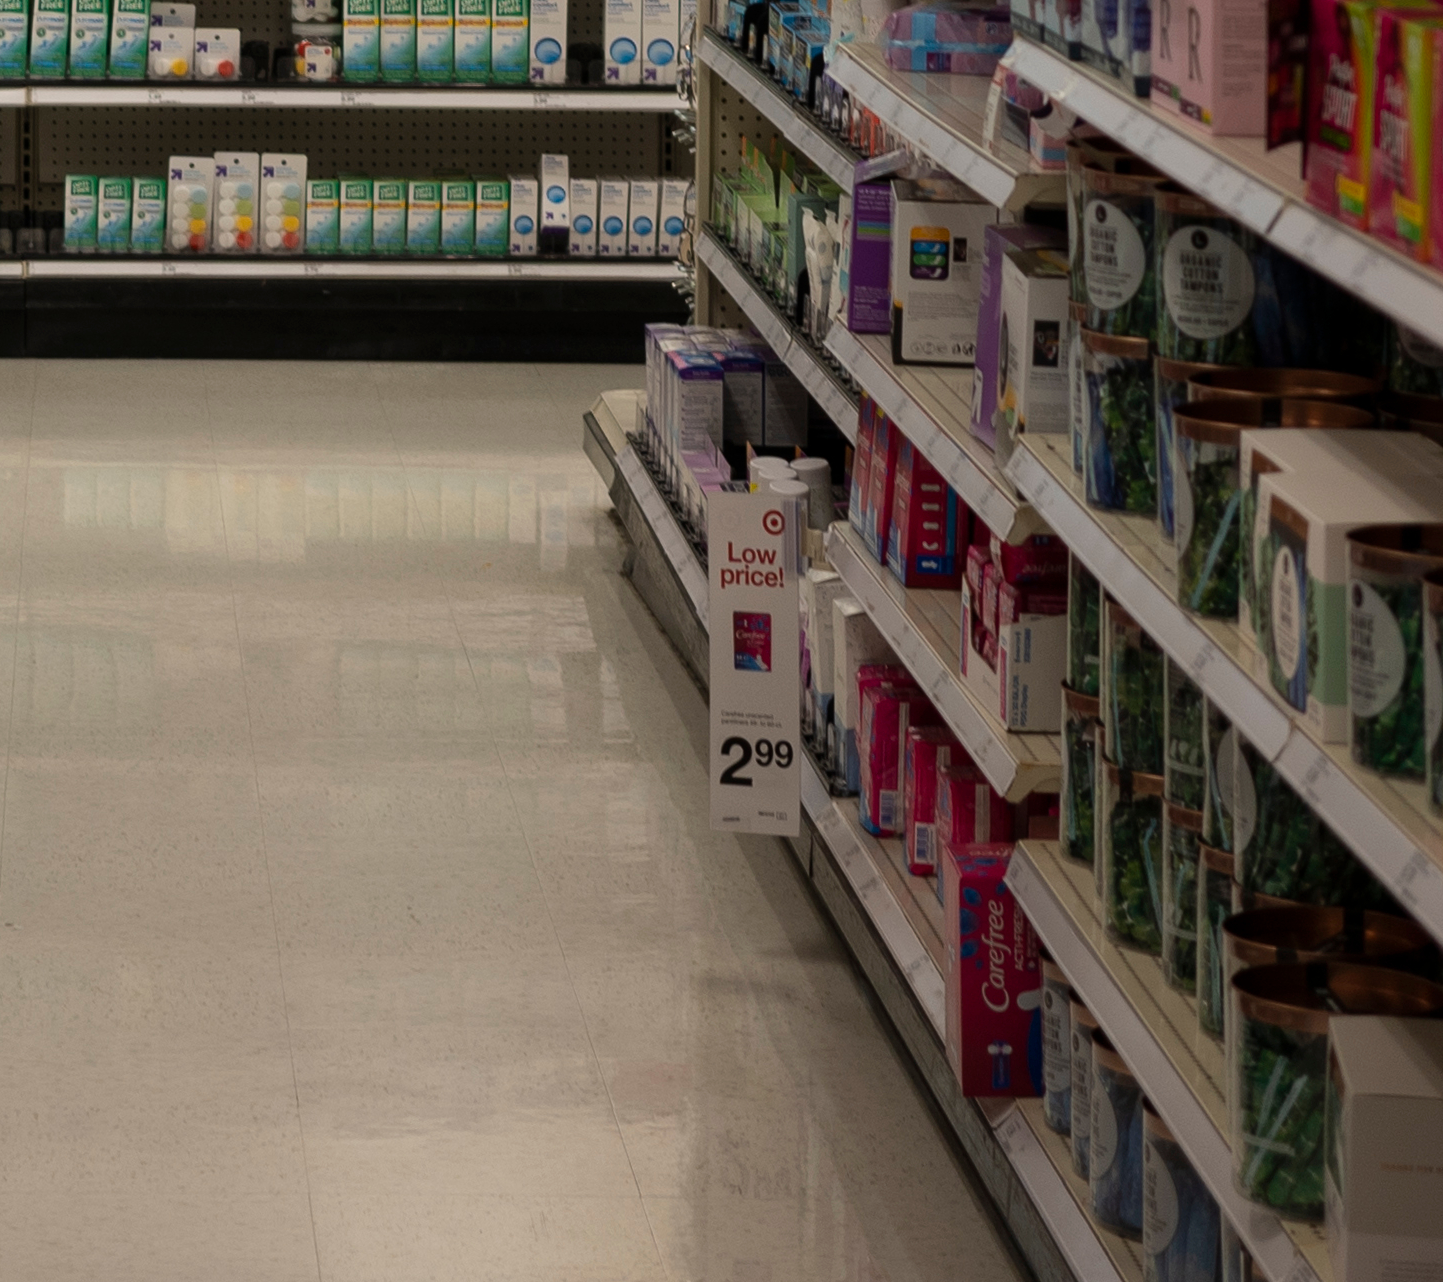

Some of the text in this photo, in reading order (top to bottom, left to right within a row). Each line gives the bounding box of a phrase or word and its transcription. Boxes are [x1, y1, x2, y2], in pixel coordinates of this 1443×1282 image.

[1323, 83, 1358, 131] SPORT
[1179, 251, 1223, 268] ORGANIC
[1182, 267, 1219, 281] COTTON
[1180, 279, 1224, 294] TAMPONS
[727, 541, 777, 565] Low
[720, 564, 785, 589] price!
[981, 898, 1011, 1014] Carefree
